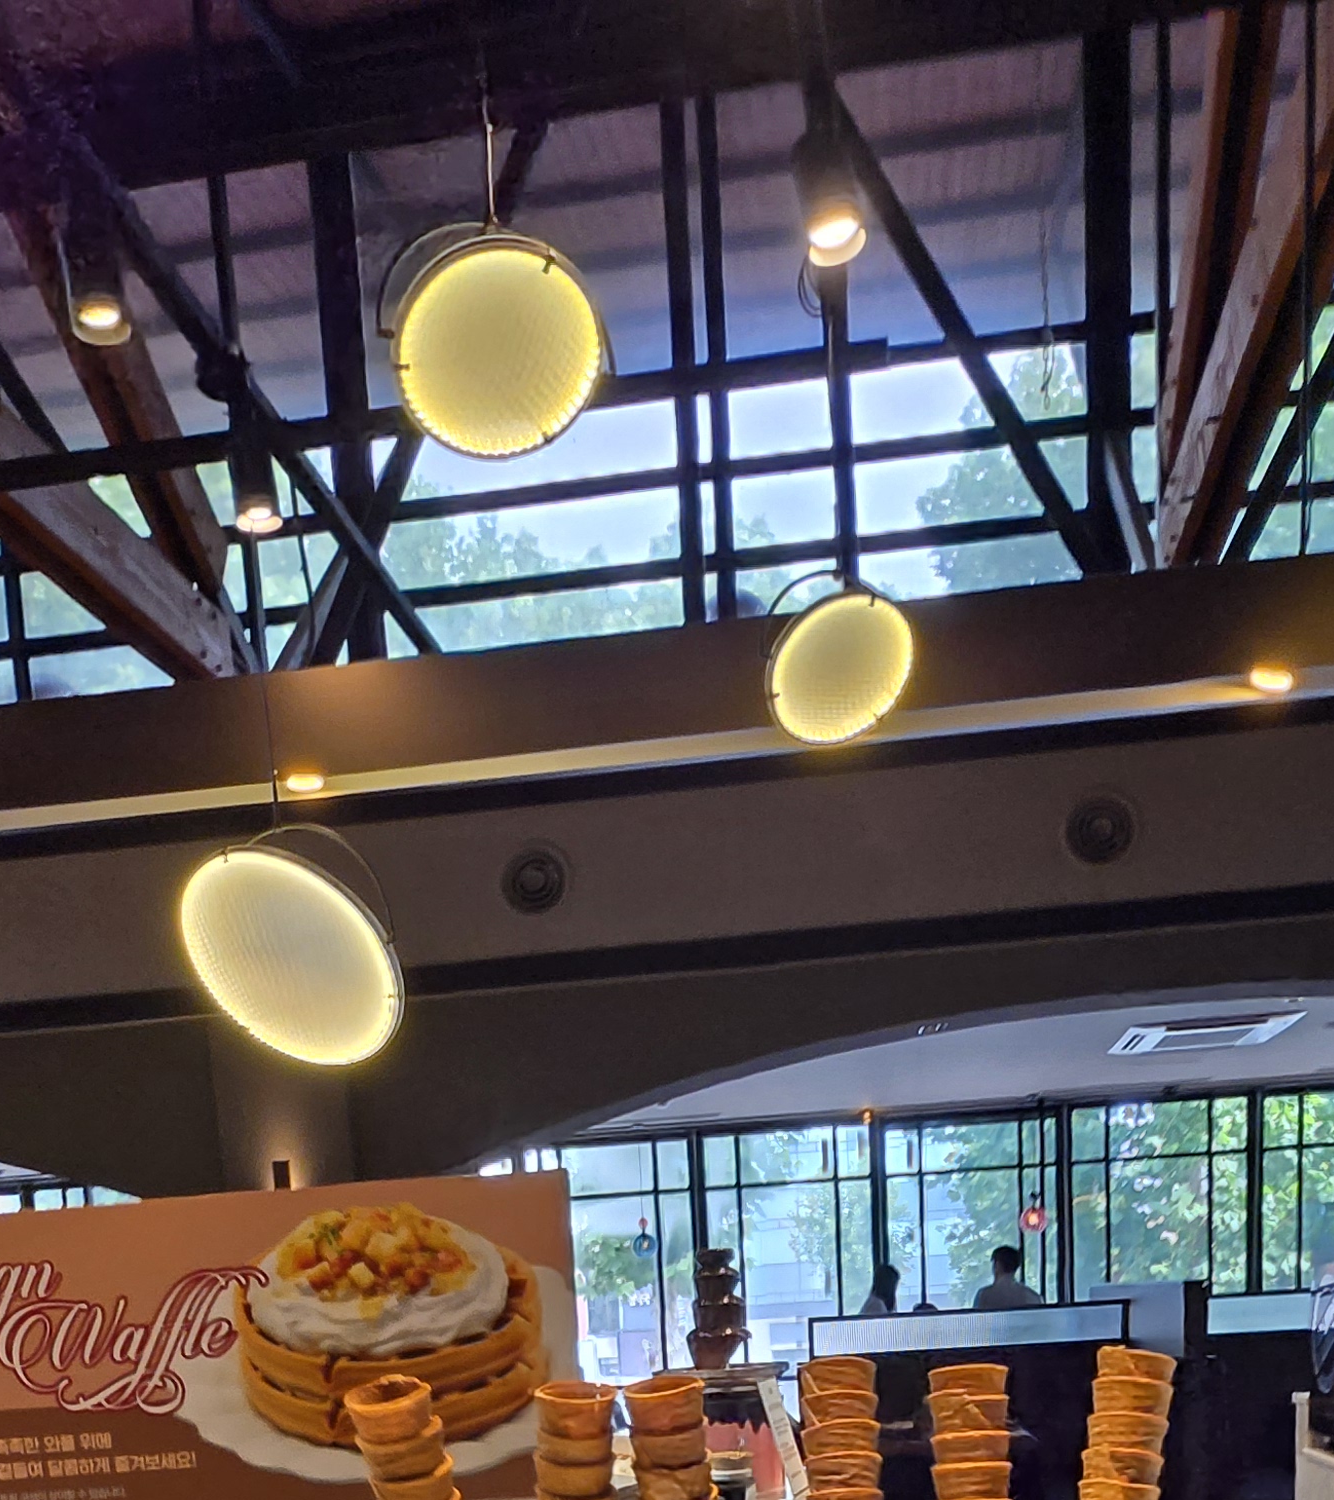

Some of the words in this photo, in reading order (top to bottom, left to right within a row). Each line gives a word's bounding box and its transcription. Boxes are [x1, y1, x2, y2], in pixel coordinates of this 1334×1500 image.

[44, 1434, 75, 1453] 와플
[80, 1432, 112, 1450] 위에
[48, 1456, 111, 1478] 달콤하게
[115, 1451, 197, 1473] 즐겨보세요!
